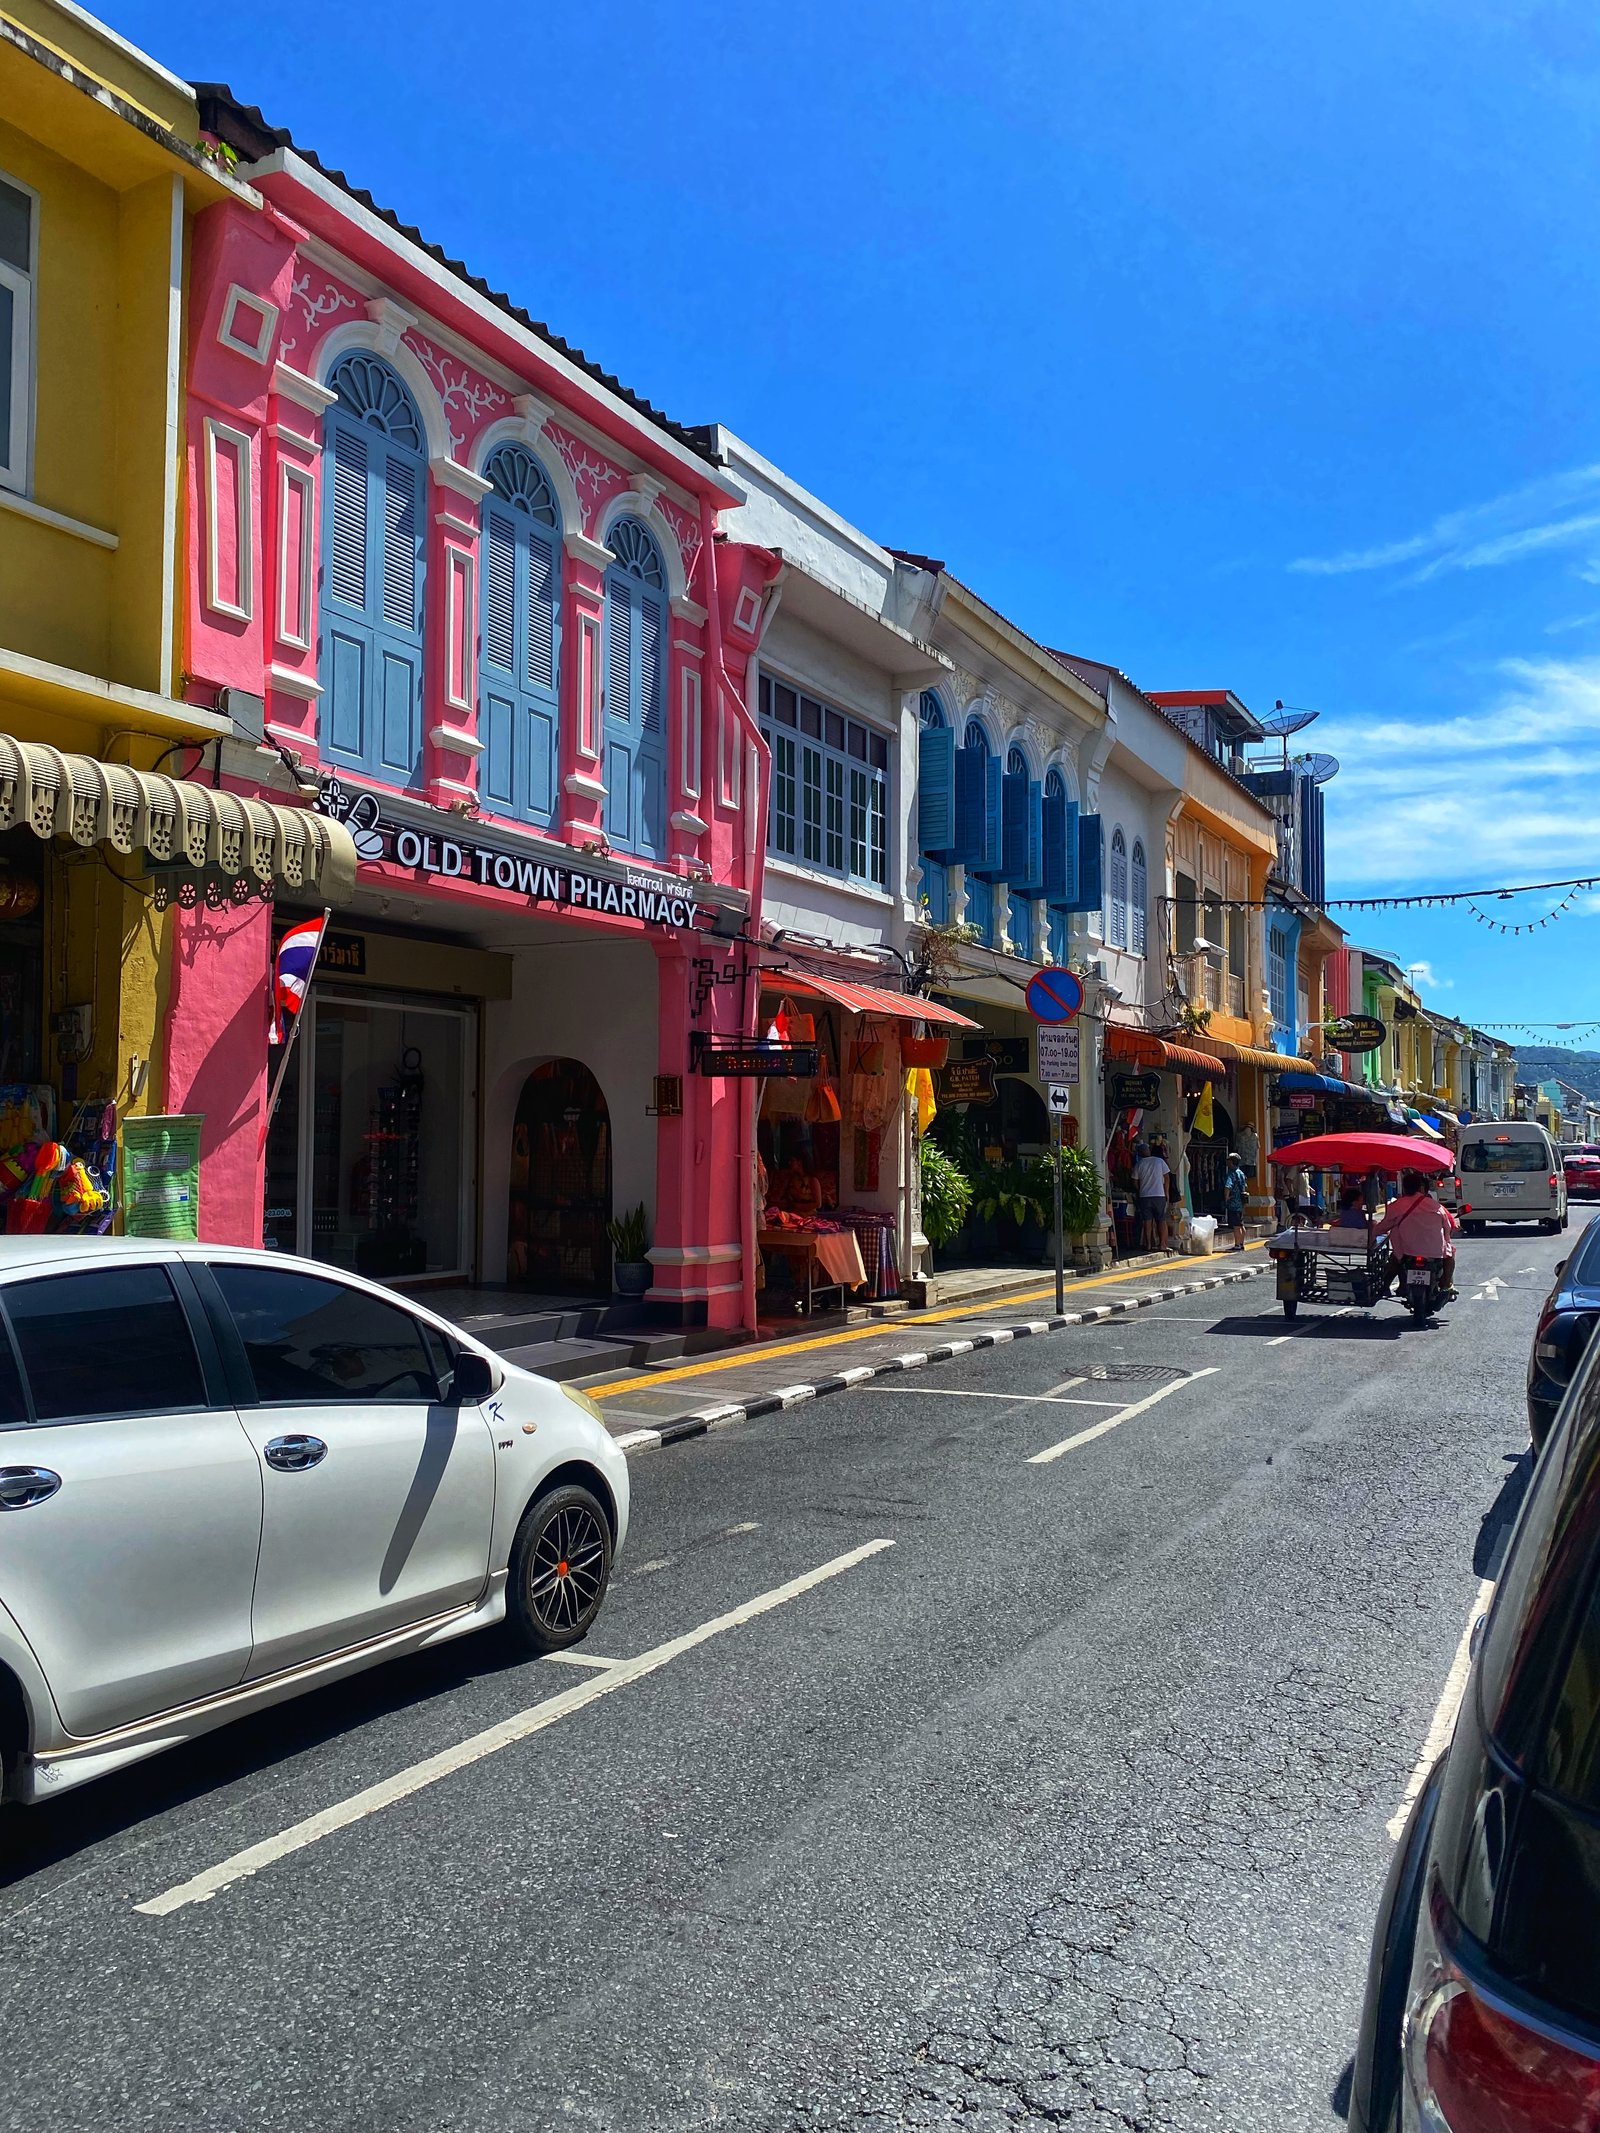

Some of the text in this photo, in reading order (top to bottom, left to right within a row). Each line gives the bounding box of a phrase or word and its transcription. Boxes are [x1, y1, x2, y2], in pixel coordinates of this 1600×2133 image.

[397, 831, 698, 929] OLD TOWN PHARMACY
[1040, 1046, 1077, 1058] 07.00-19.00
